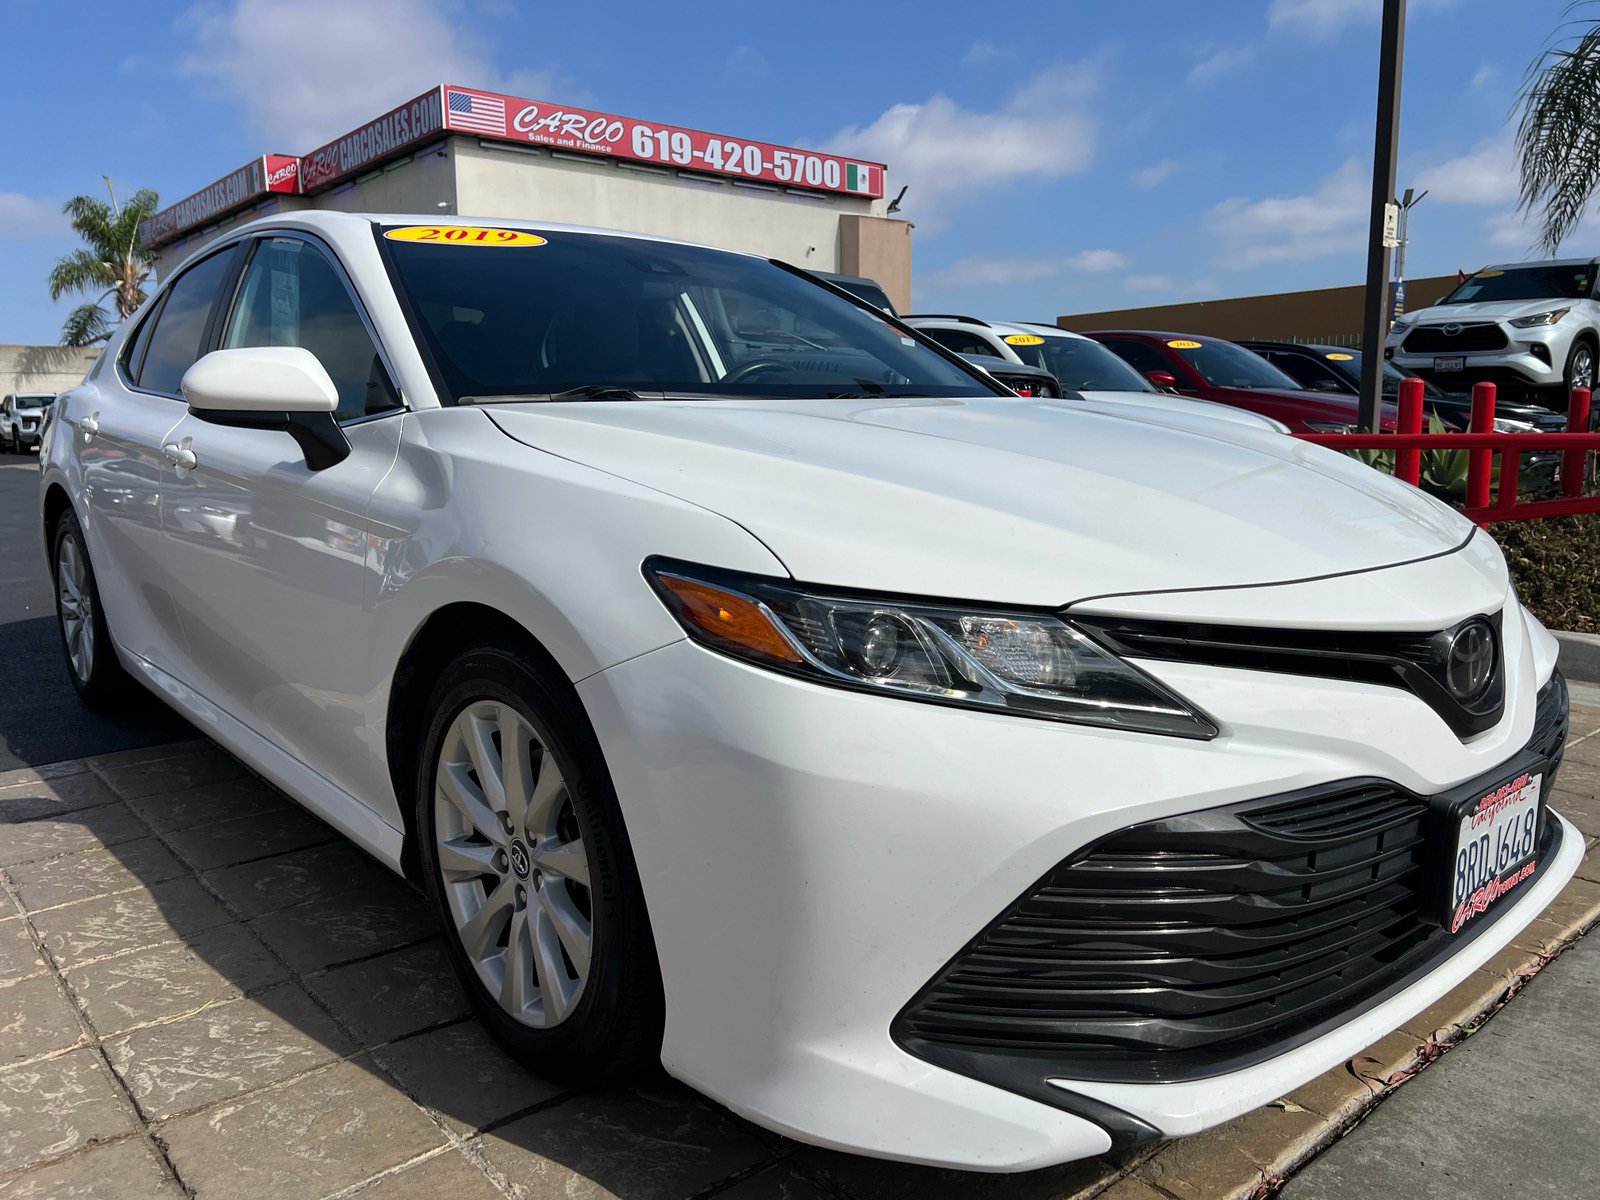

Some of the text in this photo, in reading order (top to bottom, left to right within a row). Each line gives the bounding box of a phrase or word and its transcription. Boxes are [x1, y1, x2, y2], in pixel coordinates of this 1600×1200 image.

[302, 92, 441, 185] CARCO CARCOSALES.COM
[513, 100, 841, 189] CARCO 619-420-5700
[528, 132, 612, 153] Sales and Finance
[175, 170, 248, 230] CARCOSALES.COM
[267, 163, 297, 185] CARCO
[417, 228, 519, 243] 2019
[1455, 807, 1535, 902] 8RDJ648
